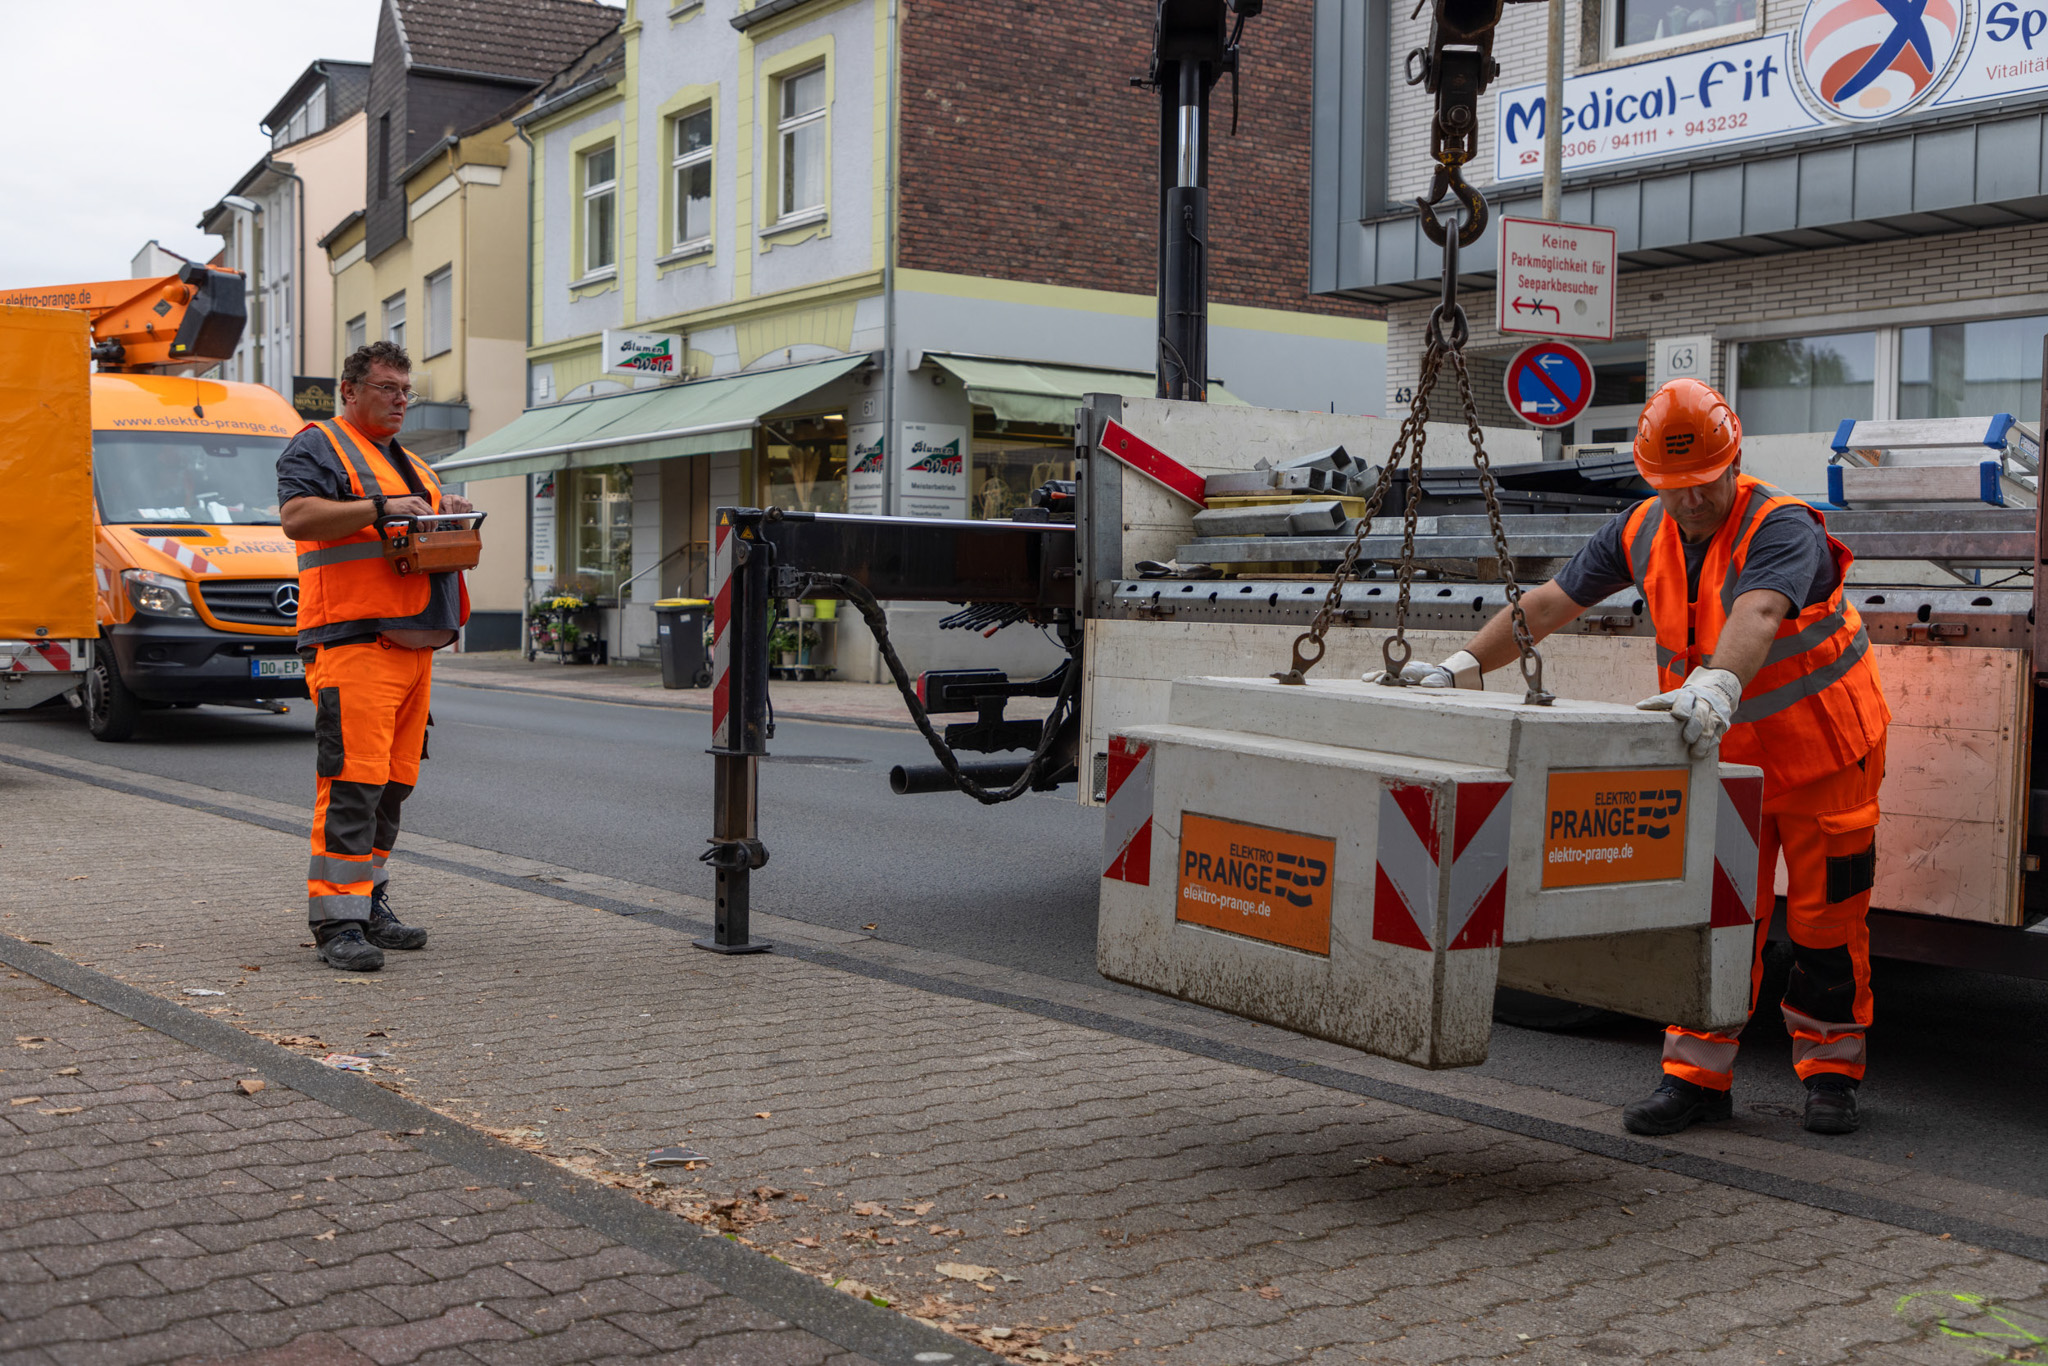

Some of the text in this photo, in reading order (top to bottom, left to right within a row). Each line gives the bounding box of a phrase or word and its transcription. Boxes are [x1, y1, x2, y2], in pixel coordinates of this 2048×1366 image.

[1505, 55, 1778, 144] Medical-Fit
[1611, 128, 1658, 150] 941111
[1685, 112, 1748, 137] 943232
[1542, 233, 1577, 251] Keine
[1511, 252, 1606, 275] Parkmöglichkeit für
[1518, 274, 1598, 295] Seeparkbesucher
[621, 340, 663, 353] Blumen
[632, 356, 671, 374] Wolf
[1672, 349, 1693, 369] 63
[1395, 387, 1411, 403] 63
[864, 401, 873, 415] 61
[113, 416, 288, 435] www.elektro-prange.de
[911, 440, 954, 455] Blumen
[922, 459, 961, 476] Wolf
[201, 544, 291, 556] PRANGE
[261, 661, 276, 675] DO
[284, 661, 299, 674] EP
[1595, 791, 1637, 806] ELEKTRO
[1550, 807, 1635, 839] PRANGE
[1229, 843, 1274, 864] ELEKTRO
[1548, 843, 1634, 864] elektro-prange.de
[1184, 850, 1273, 895] PRANGE
[1183, 885, 1271, 917] elektro-prange.de
